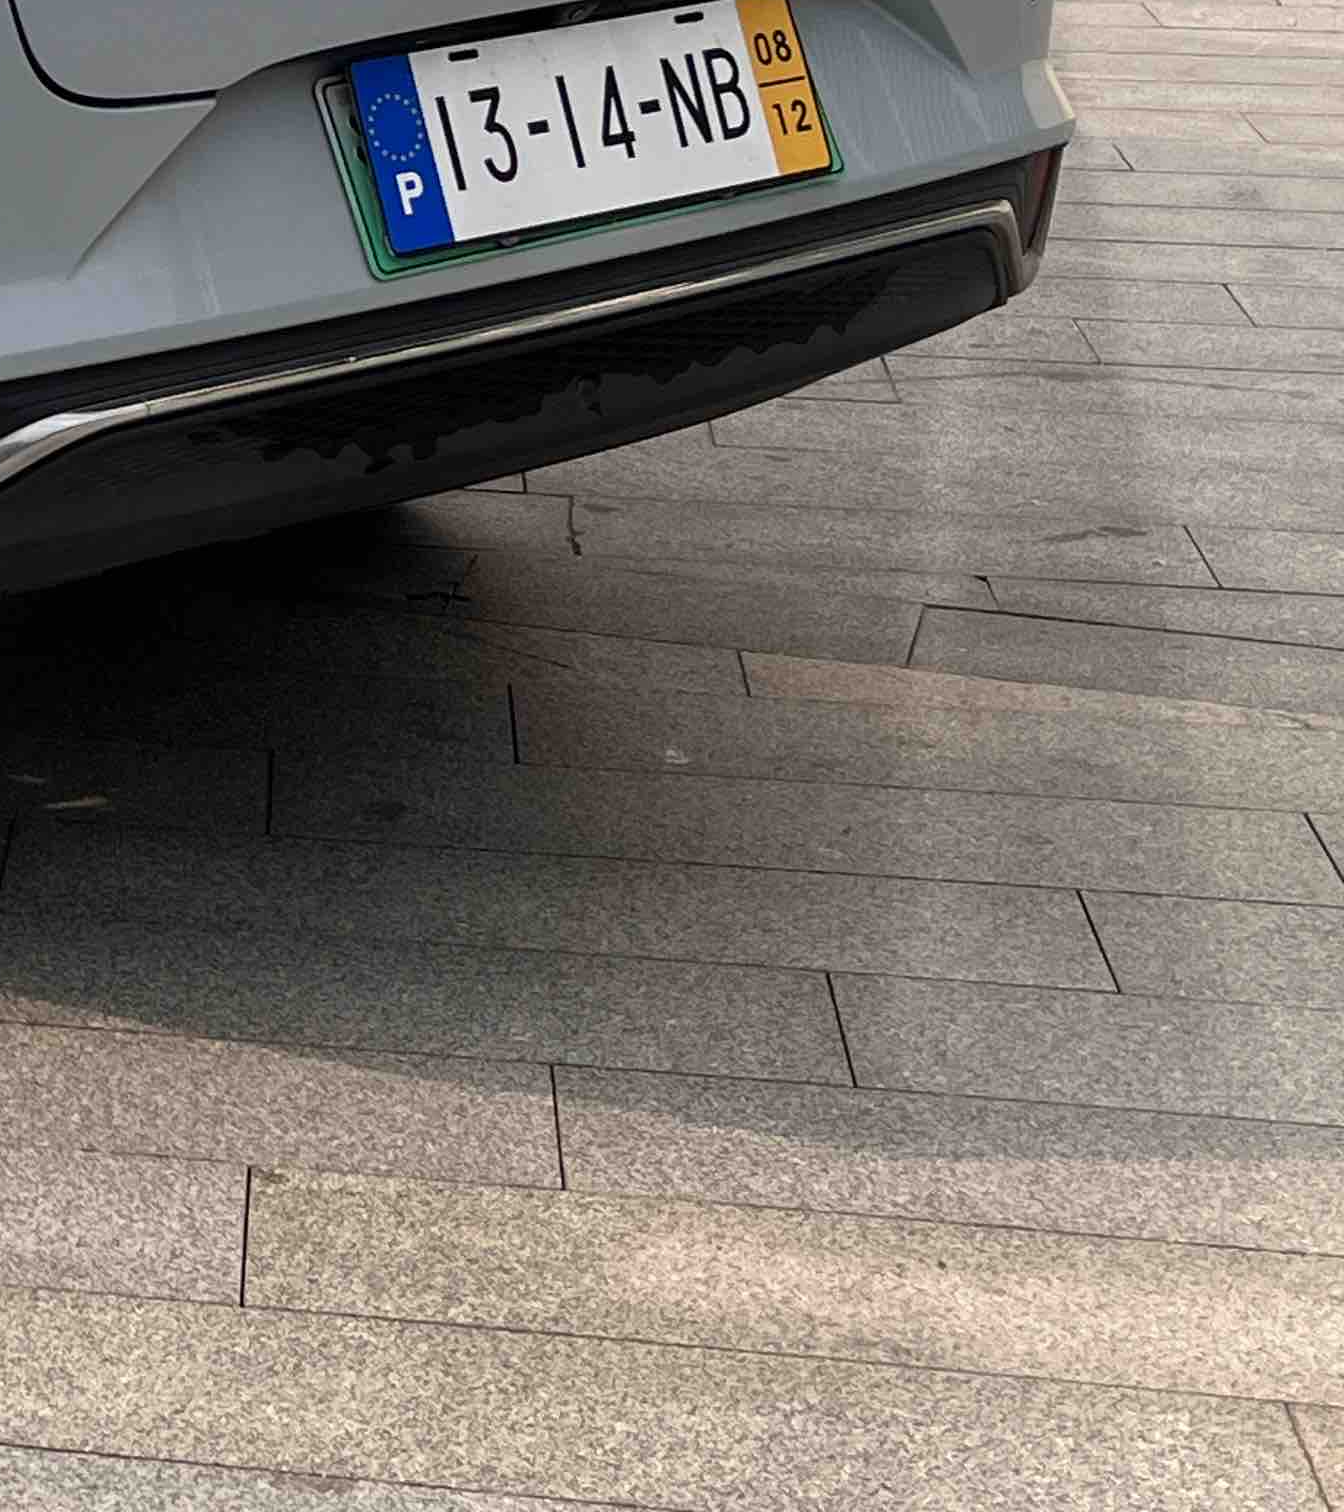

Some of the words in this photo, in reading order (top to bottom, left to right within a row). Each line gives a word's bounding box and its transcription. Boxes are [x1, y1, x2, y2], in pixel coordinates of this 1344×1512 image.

[753, 28, 793, 66] 08
[435, 47, 752, 191] 13-14-NB
[771, 98, 813, 138] 12
[395, 171, 425, 216] P
